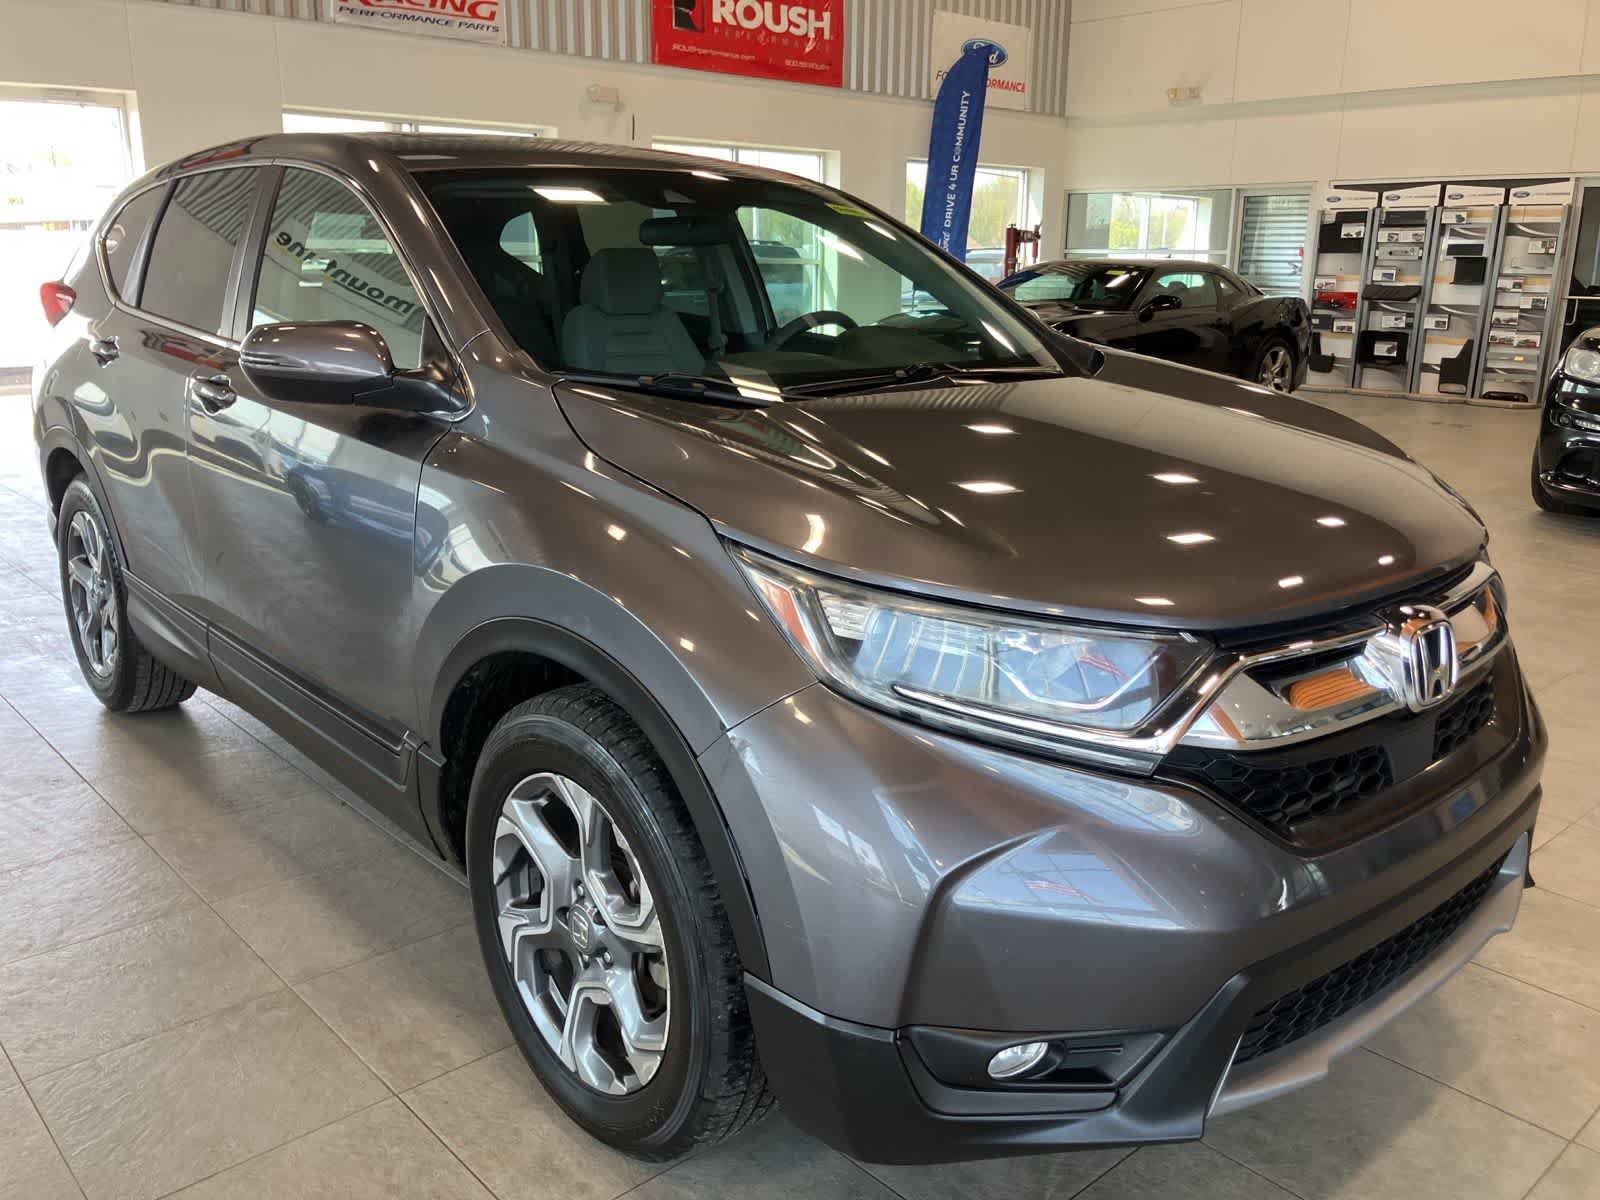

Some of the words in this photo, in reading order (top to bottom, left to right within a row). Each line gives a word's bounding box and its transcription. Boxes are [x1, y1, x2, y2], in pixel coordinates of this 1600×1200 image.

[338, 6, 456, 27] PERFORMANCE
[458, 21, 500, 32] PARTS
[712, 0, 831, 40] ROUSH
[950, 165, 960, 181] UR
[949, 183, 957, 191] 4
[944, 193, 956, 228] DRIVE
